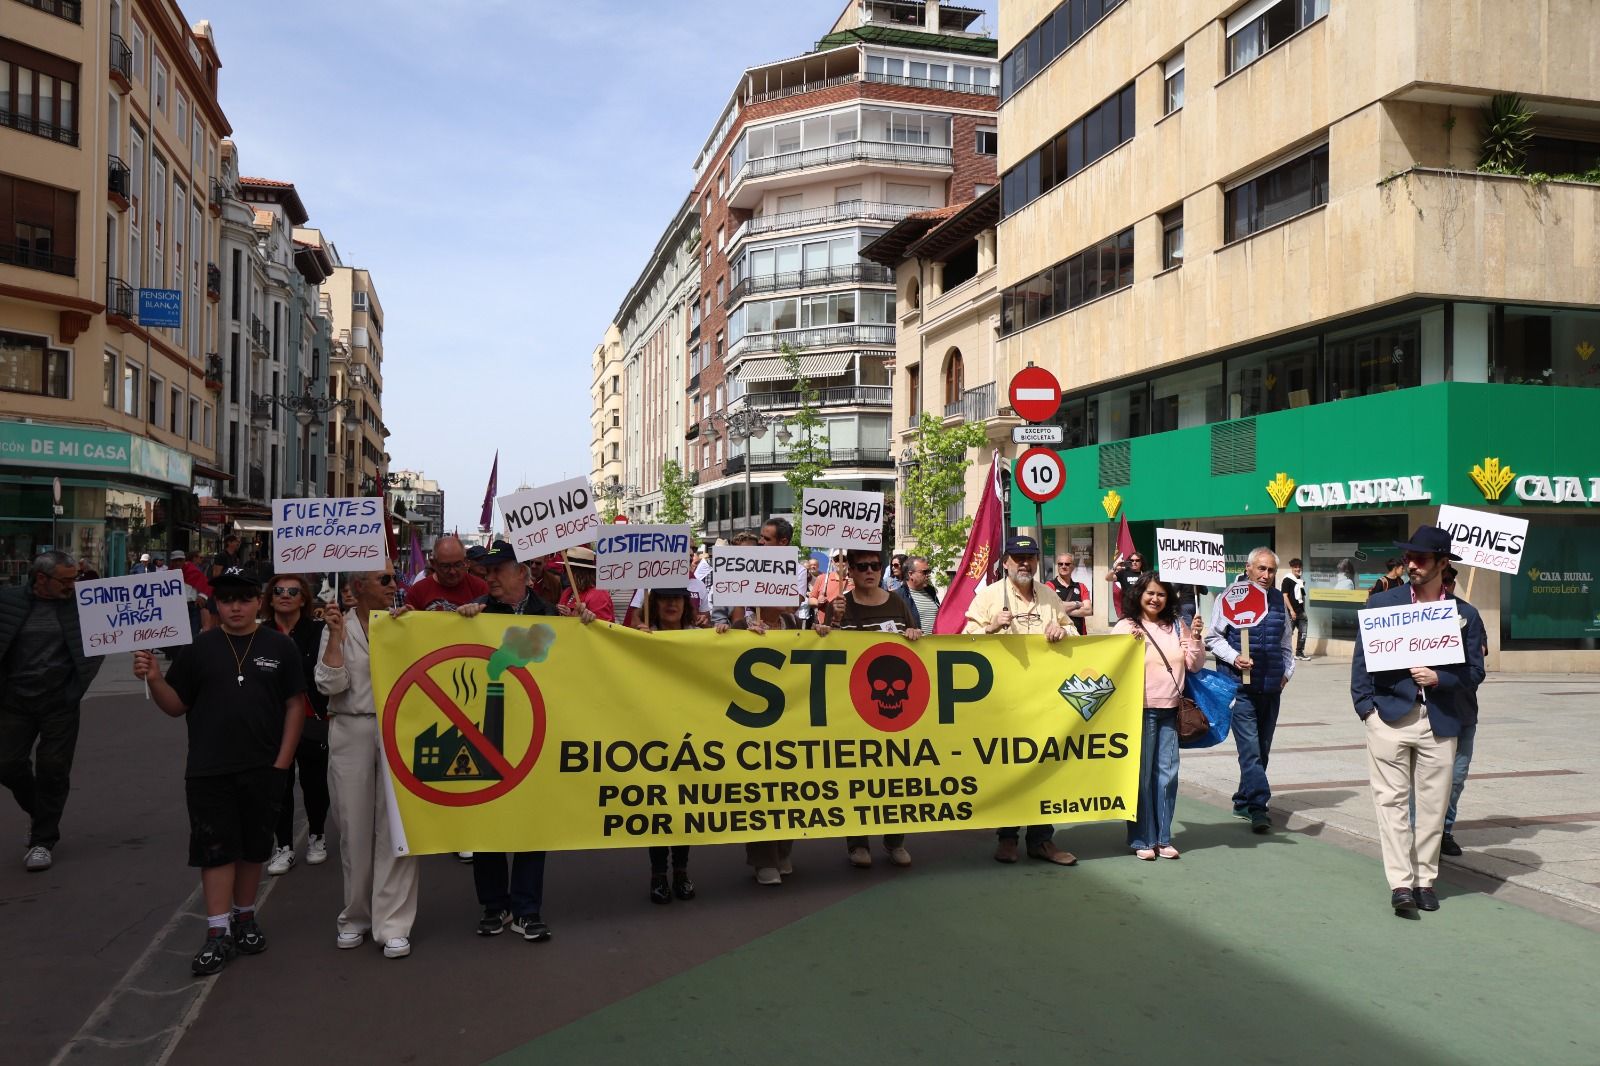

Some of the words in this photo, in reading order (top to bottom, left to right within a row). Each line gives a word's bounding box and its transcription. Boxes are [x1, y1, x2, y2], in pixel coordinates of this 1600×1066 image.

[140, 291, 180, 300] PENSIÓN
[145, 301, 179, 309] BLANCA
[31, 439, 54, 455] DE
[59, 441, 79, 457] MI
[84, 443, 128, 461] CASA
[1030, 466, 1053, 484] 10
[1295, 482, 1347, 507] CAJA
[1348, 475, 1432, 504] RURAL
[1515, 475, 1588, 504] CAJA
[283, 500, 376, 521] FUENTES
[804, 498, 881, 523] SORRIBA
[277, 523, 382, 539] PEÑACORADA
[517, 527, 549, 551] STOP
[555, 513, 599, 539] BIOGAS
[804, 524, 836, 537] STOP
[841, 525, 882, 544] BIOGAS
[280, 543, 317, 563] STOP
[323, 544, 379, 559] BIOGAS
[597, 532, 688, 555] CISTIERNA
[1158, 538, 1225, 557] VALMARTINO
[599, 561, 633, 581] STOP
[637, 559, 689, 579] BIOGAS
[714, 556, 797, 576] PESQUERA
[1161, 556, 1187, 571] STOP
[1189, 557, 1225, 573] BIOGAS
[1474, 550, 1517, 570] BIOGAS
[1540, 571, 1561, 581] CAJA
[1563, 572, 1593, 581] RURAL
[79, 586, 130, 606] SANTA
[133, 579, 182, 600] OLAJA
[715, 579, 750, 594] STOP
[754, 581, 799, 597] BIOGAS
[1231, 587, 1249, 596] STOP
[116, 602, 132, 613] DE
[138, 597, 155, 610] LA
[106, 607, 162, 629] VARGA
[1363, 606, 1454, 630] SANTIBAÑEZ
[89, 630, 124, 648] STOP
[133, 625, 179, 642] BIOGAS
[1367, 637, 1404, 654] STOP
[1409, 635, 1460, 652] BIOGAS
[560, 733, 726, 773] BIOGÁS
[736, 737, 941, 772] CISTIERNA
[973, 732, 1129, 765] VIDANES
[598, 784, 668, 807] POR
[678, 779, 840, 805] NUESTROS
[849, 776, 979, 800] PUEBLOS
[1040, 796, 1127, 815] EslaVIDA
[602, 813, 673, 837] POR
[684, 806, 847, 835] NUESTRAS
[853, 801, 974, 827] TIERRAS
